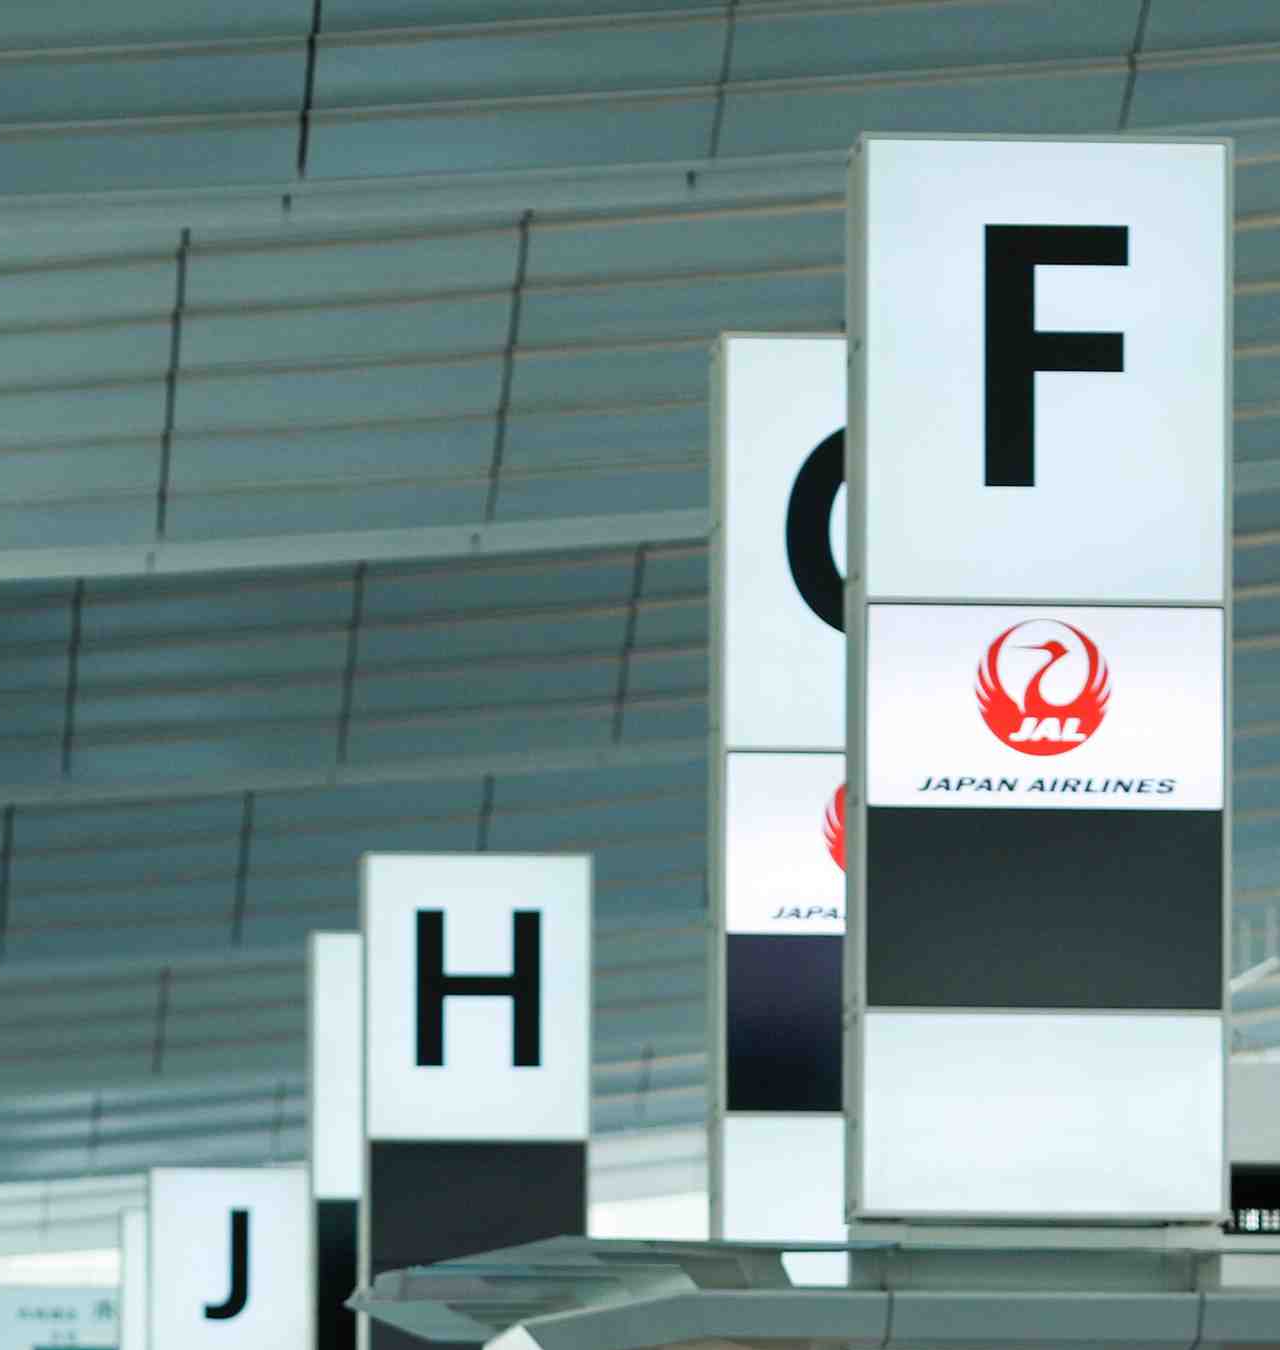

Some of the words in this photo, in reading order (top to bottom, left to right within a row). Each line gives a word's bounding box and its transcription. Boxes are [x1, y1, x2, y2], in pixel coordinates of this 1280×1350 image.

[984, 224, 1129, 487] F
[1009, 717, 1087, 742] JAL
[918, 776, 1019, 793] JAPAN
[1027, 777, 1177, 795] AIRLINES
[771, 906, 847, 919] JAPA
[416, 910, 541, 1067] H
[204, 1208, 250, 1320] J
